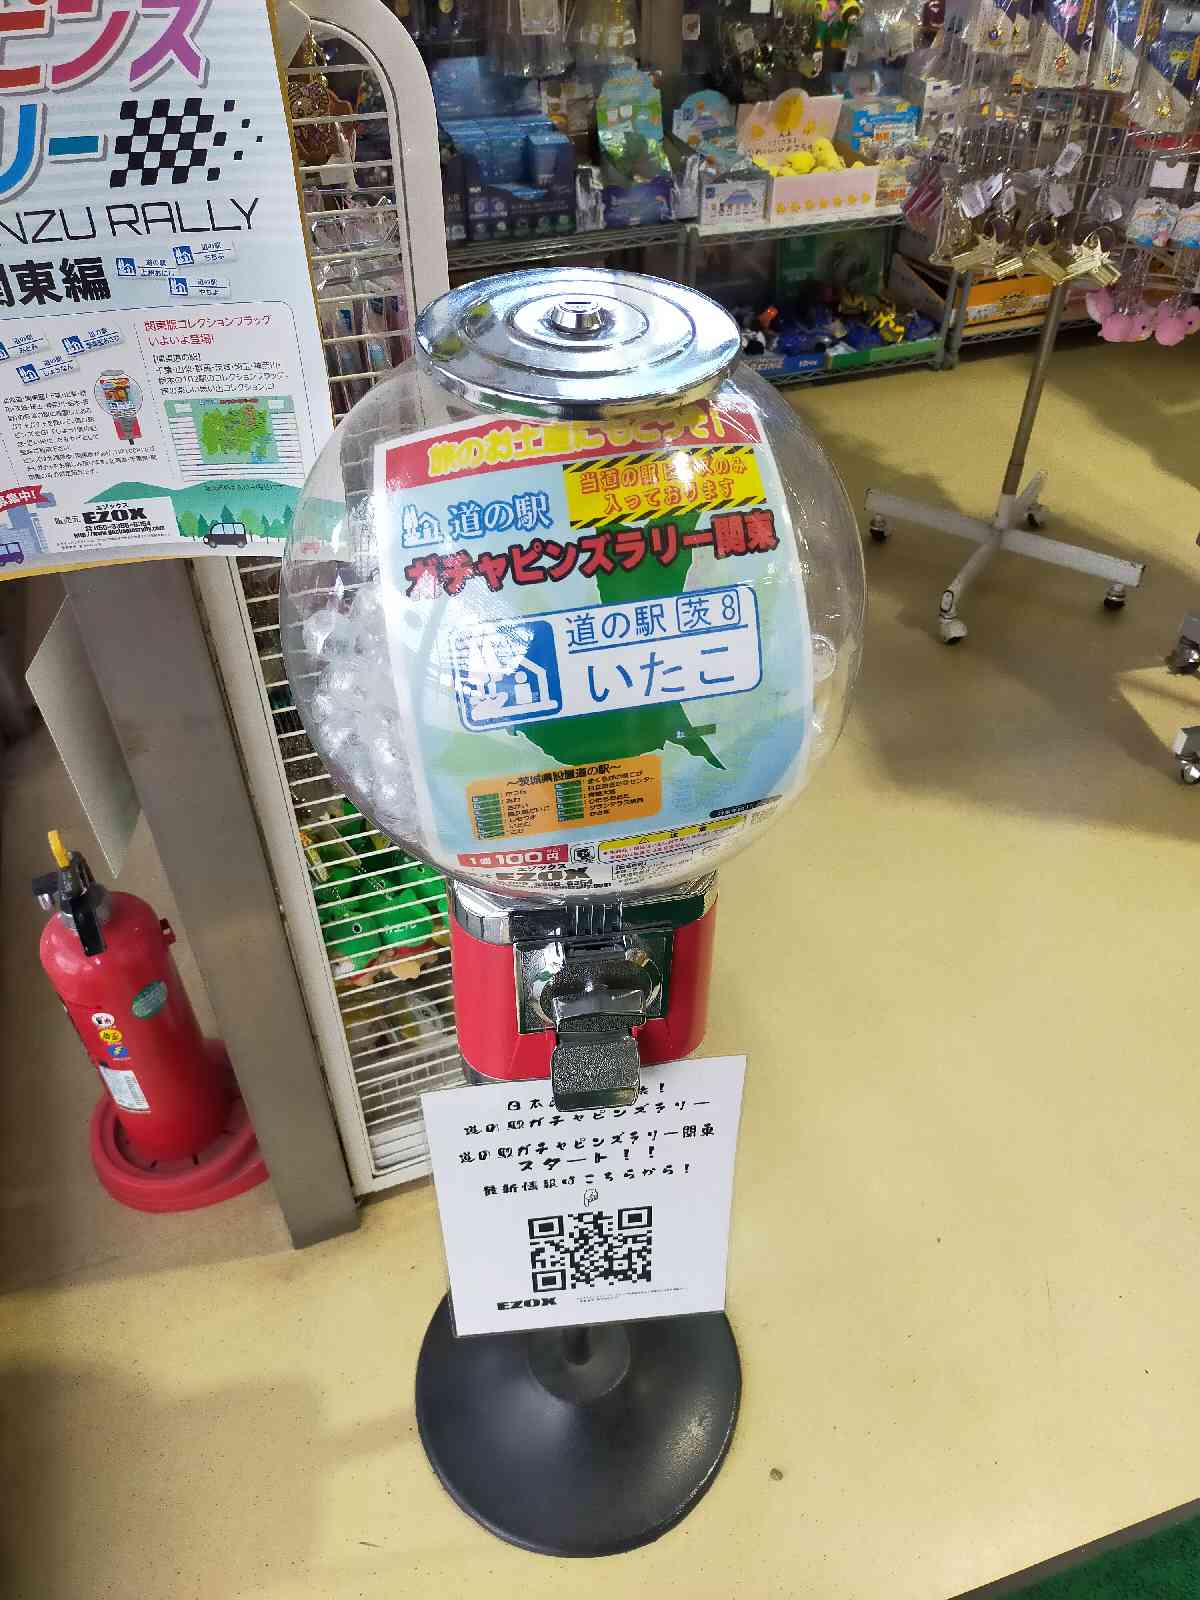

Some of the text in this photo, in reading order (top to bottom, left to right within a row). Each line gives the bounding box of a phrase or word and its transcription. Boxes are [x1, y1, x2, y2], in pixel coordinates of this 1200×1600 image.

[106, 198, 259, 237] RALLY
[448, 491, 554, 541] 道の駅
[605, 479, 736, 514] 入っております
[82, 508, 148, 525] EZOX
[404, 508, 780, 601] ガチャピンズラリー関東
[565, 604, 667, 647] 道の駅
[585, 646, 736, 702] いたこ
[464, 1101, 711, 1136] 道の駅ガチャピンズラリー
[459, 1123, 716, 1164] 道の駅ガチャピンズラリー関東
[484, 1163, 690, 1197] 最新情報はこちらから!
[496, 1296, 558, 1311] EZOX
